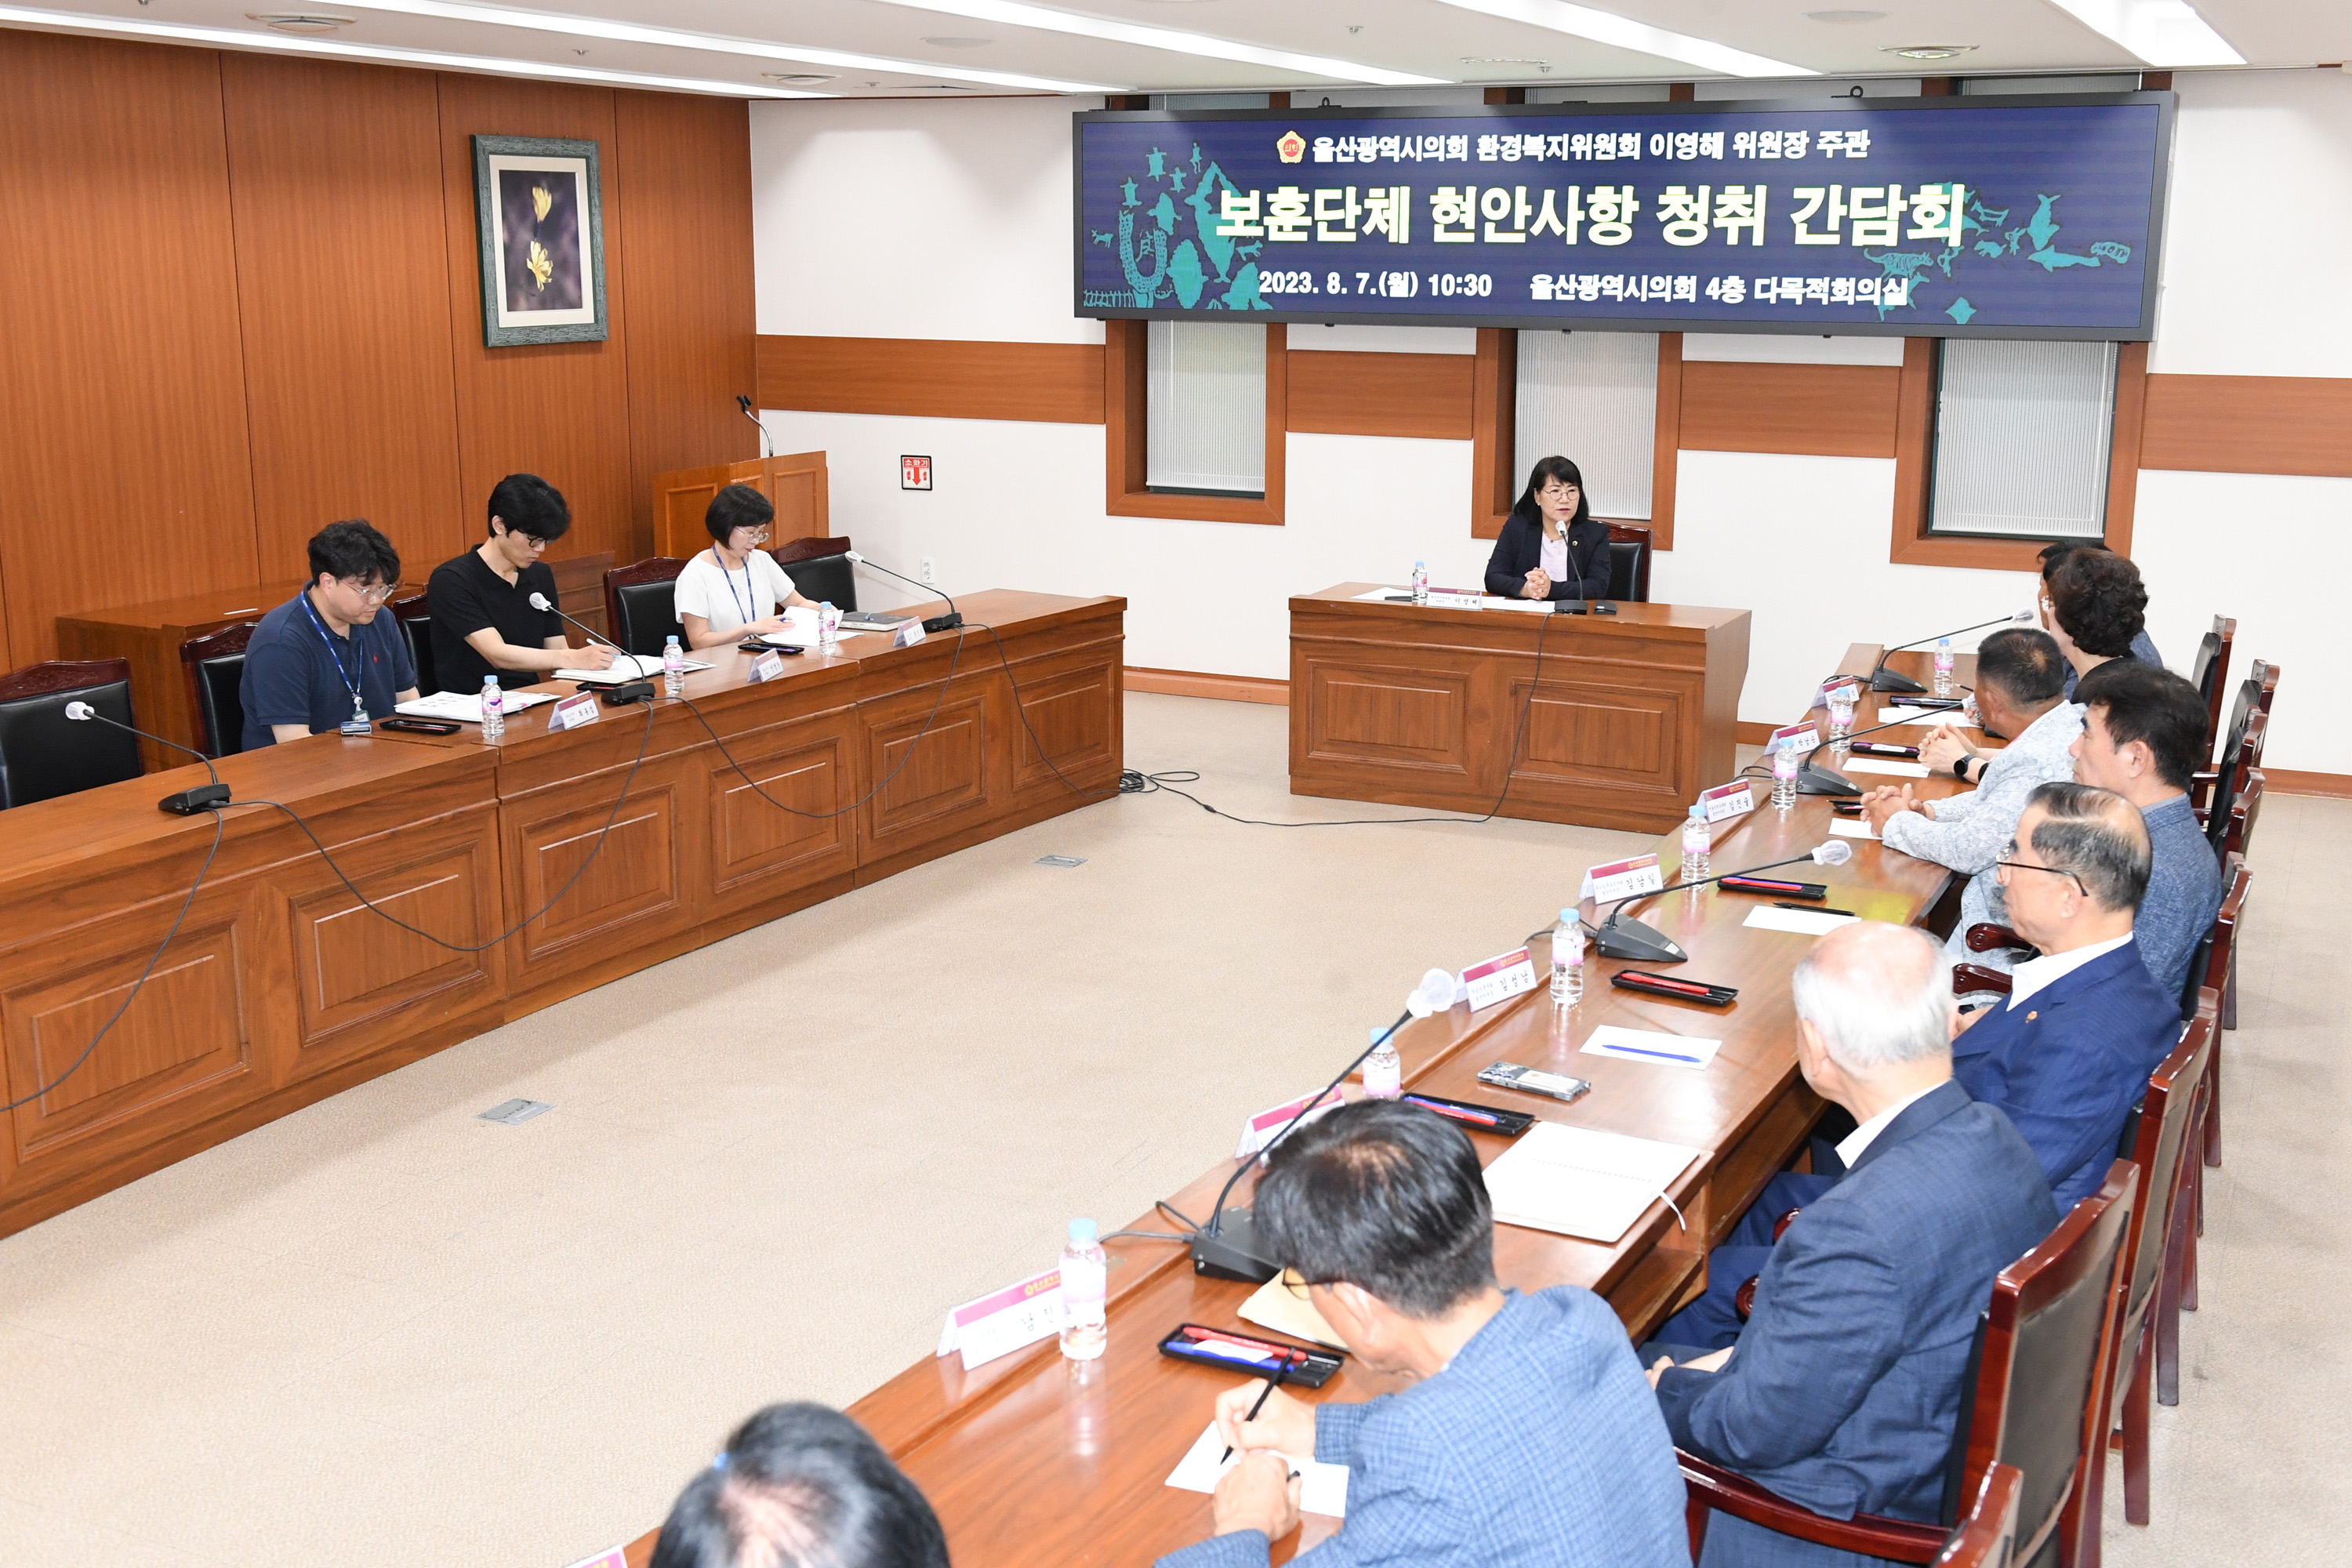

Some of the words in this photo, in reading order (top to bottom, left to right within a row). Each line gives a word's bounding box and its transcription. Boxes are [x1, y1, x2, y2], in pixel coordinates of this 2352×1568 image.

[1312, 135, 1468, 163] 울산광역시의회
[1476, 132, 1642, 162] 환경복지위원회
[1650, 132, 1725, 161] 이영해
[1732, 130, 1810, 160] 위원장
[1816, 129, 1871, 159] 주관
[1216, 186, 1410, 244] 보훈단체
[1429, 185, 1639, 246] 현안사항
[1656, 184, 1767, 247] 청취
[1790, 183, 1966, 247] 간담회
[1258, 270, 1319, 294] 2023.
[1327, 271, 1348, 295] 8.
[1356, 270, 1418, 299] 7.(월)
[1428, 273, 1493, 298] 10:30
[1530, 274, 1697, 303] 울산광역시의회
[1705, 275, 1747, 305] 4층
[1754, 276, 1910, 307] 다목적회의실
